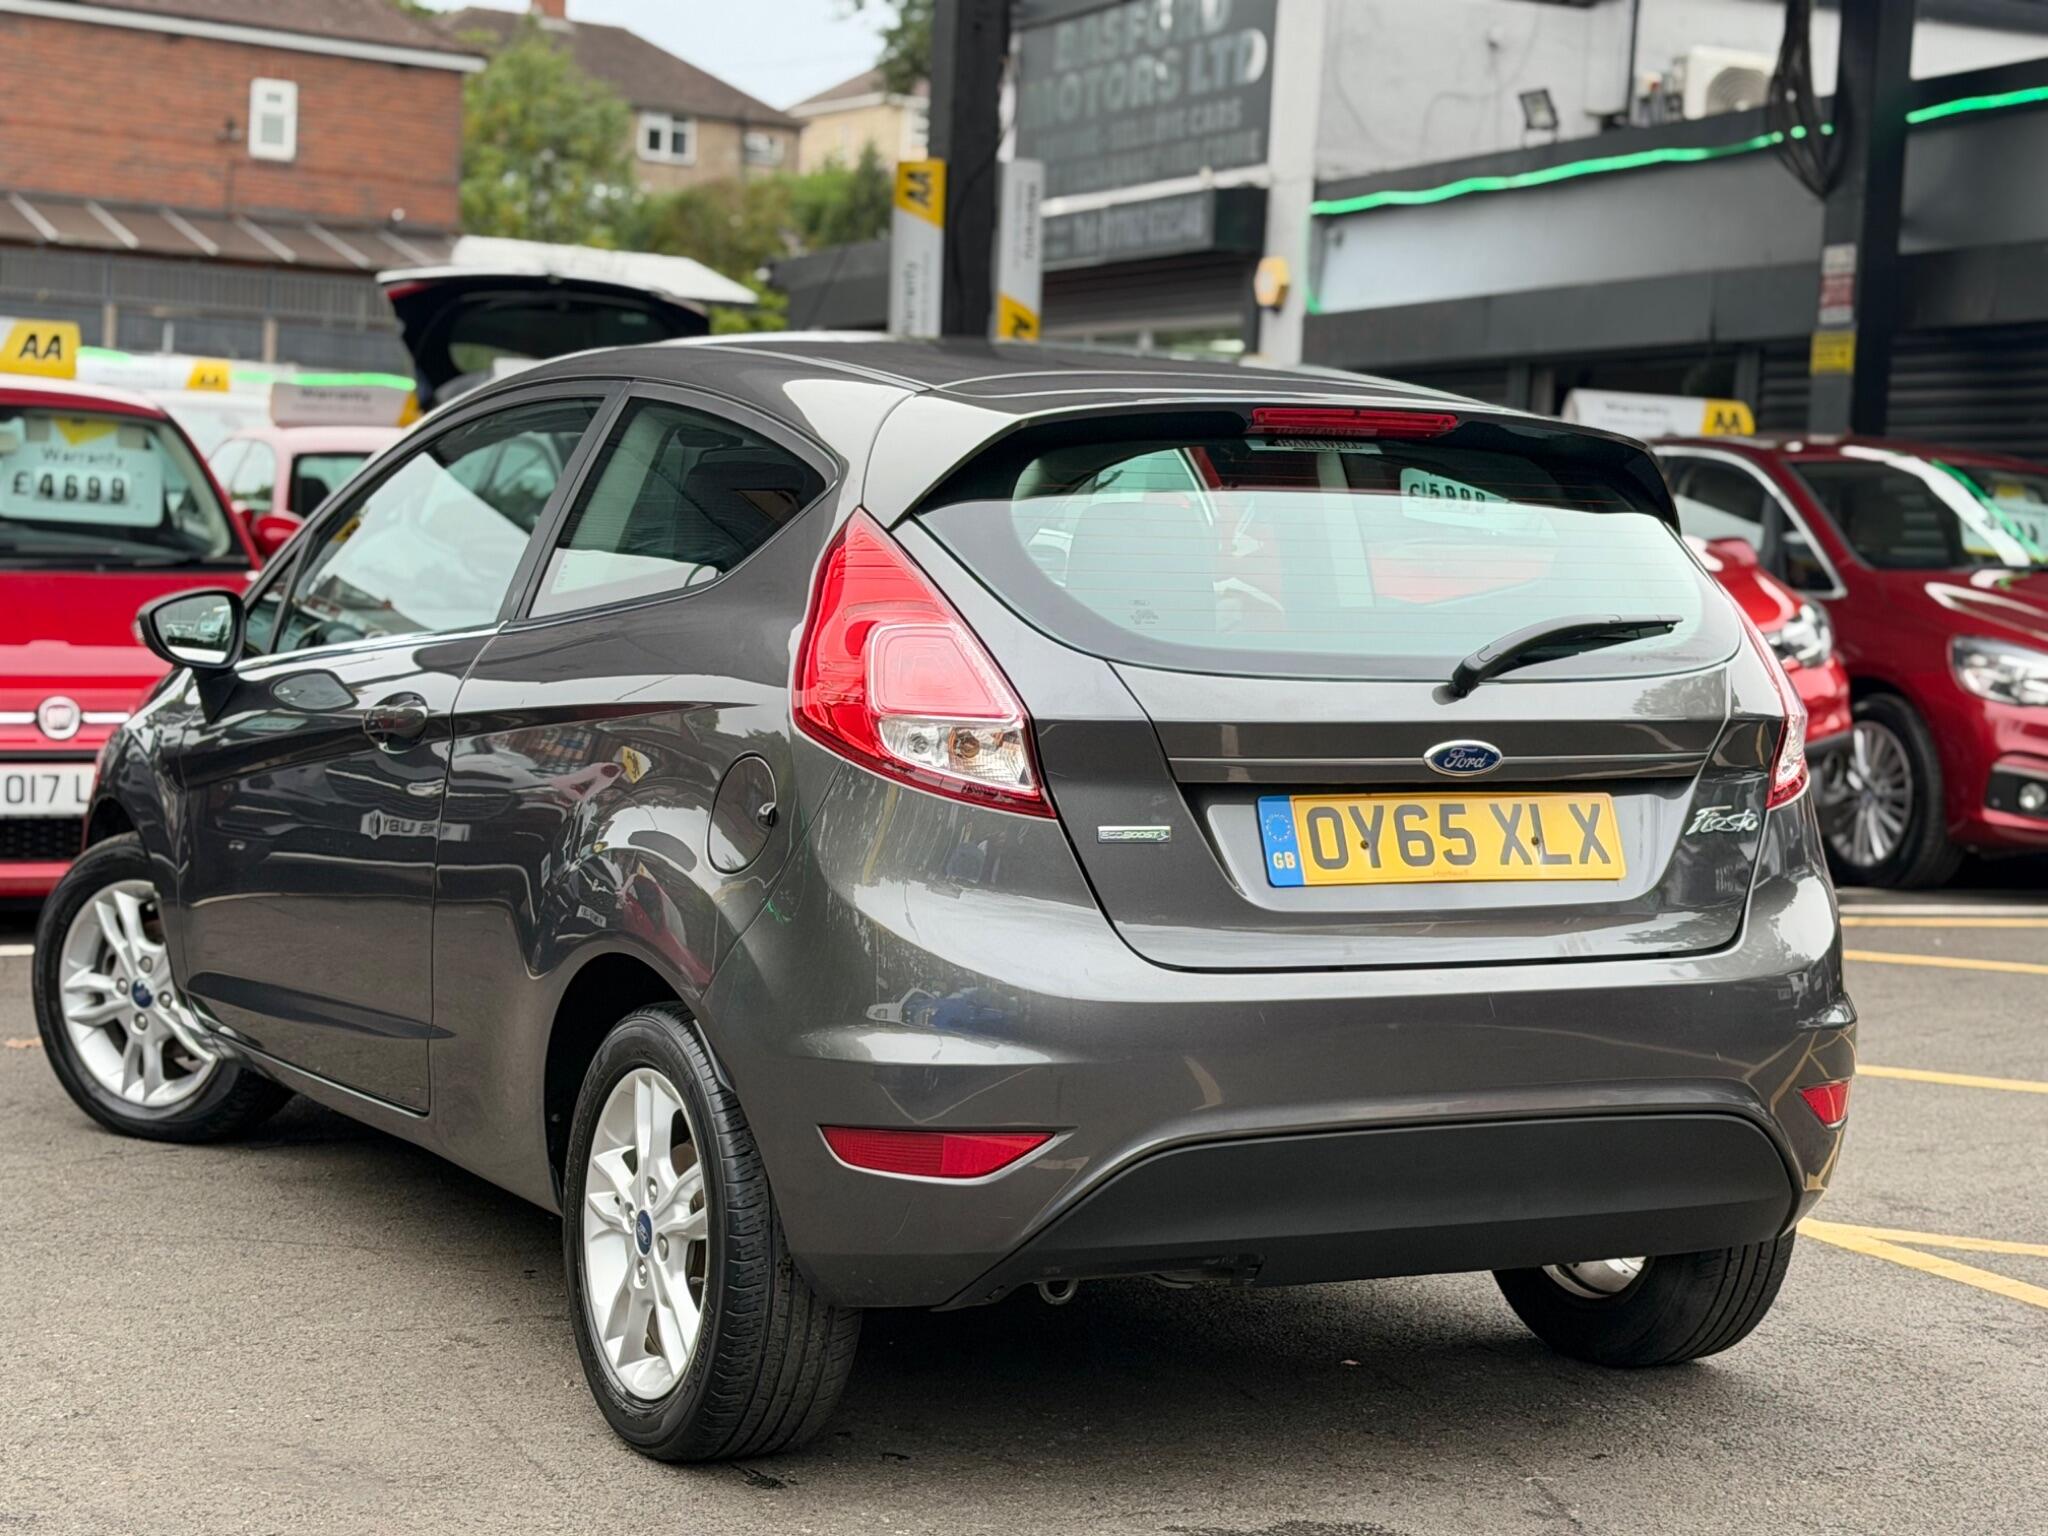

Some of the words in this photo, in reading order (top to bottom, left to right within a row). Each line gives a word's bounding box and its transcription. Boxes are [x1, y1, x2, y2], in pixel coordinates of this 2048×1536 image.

[1189, 28, 1268, 95] LTD
[18, 333, 61, 361] AA
[13, 471, 126, 503] £4699
[1443, 747, 1489, 768] Ford
[1685, 805, 1759, 836] Fiesta
[1305, 803, 1478, 871] OY65
[1489, 803, 1613, 867] XLX
[1273, 851, 1296, 869] GB
